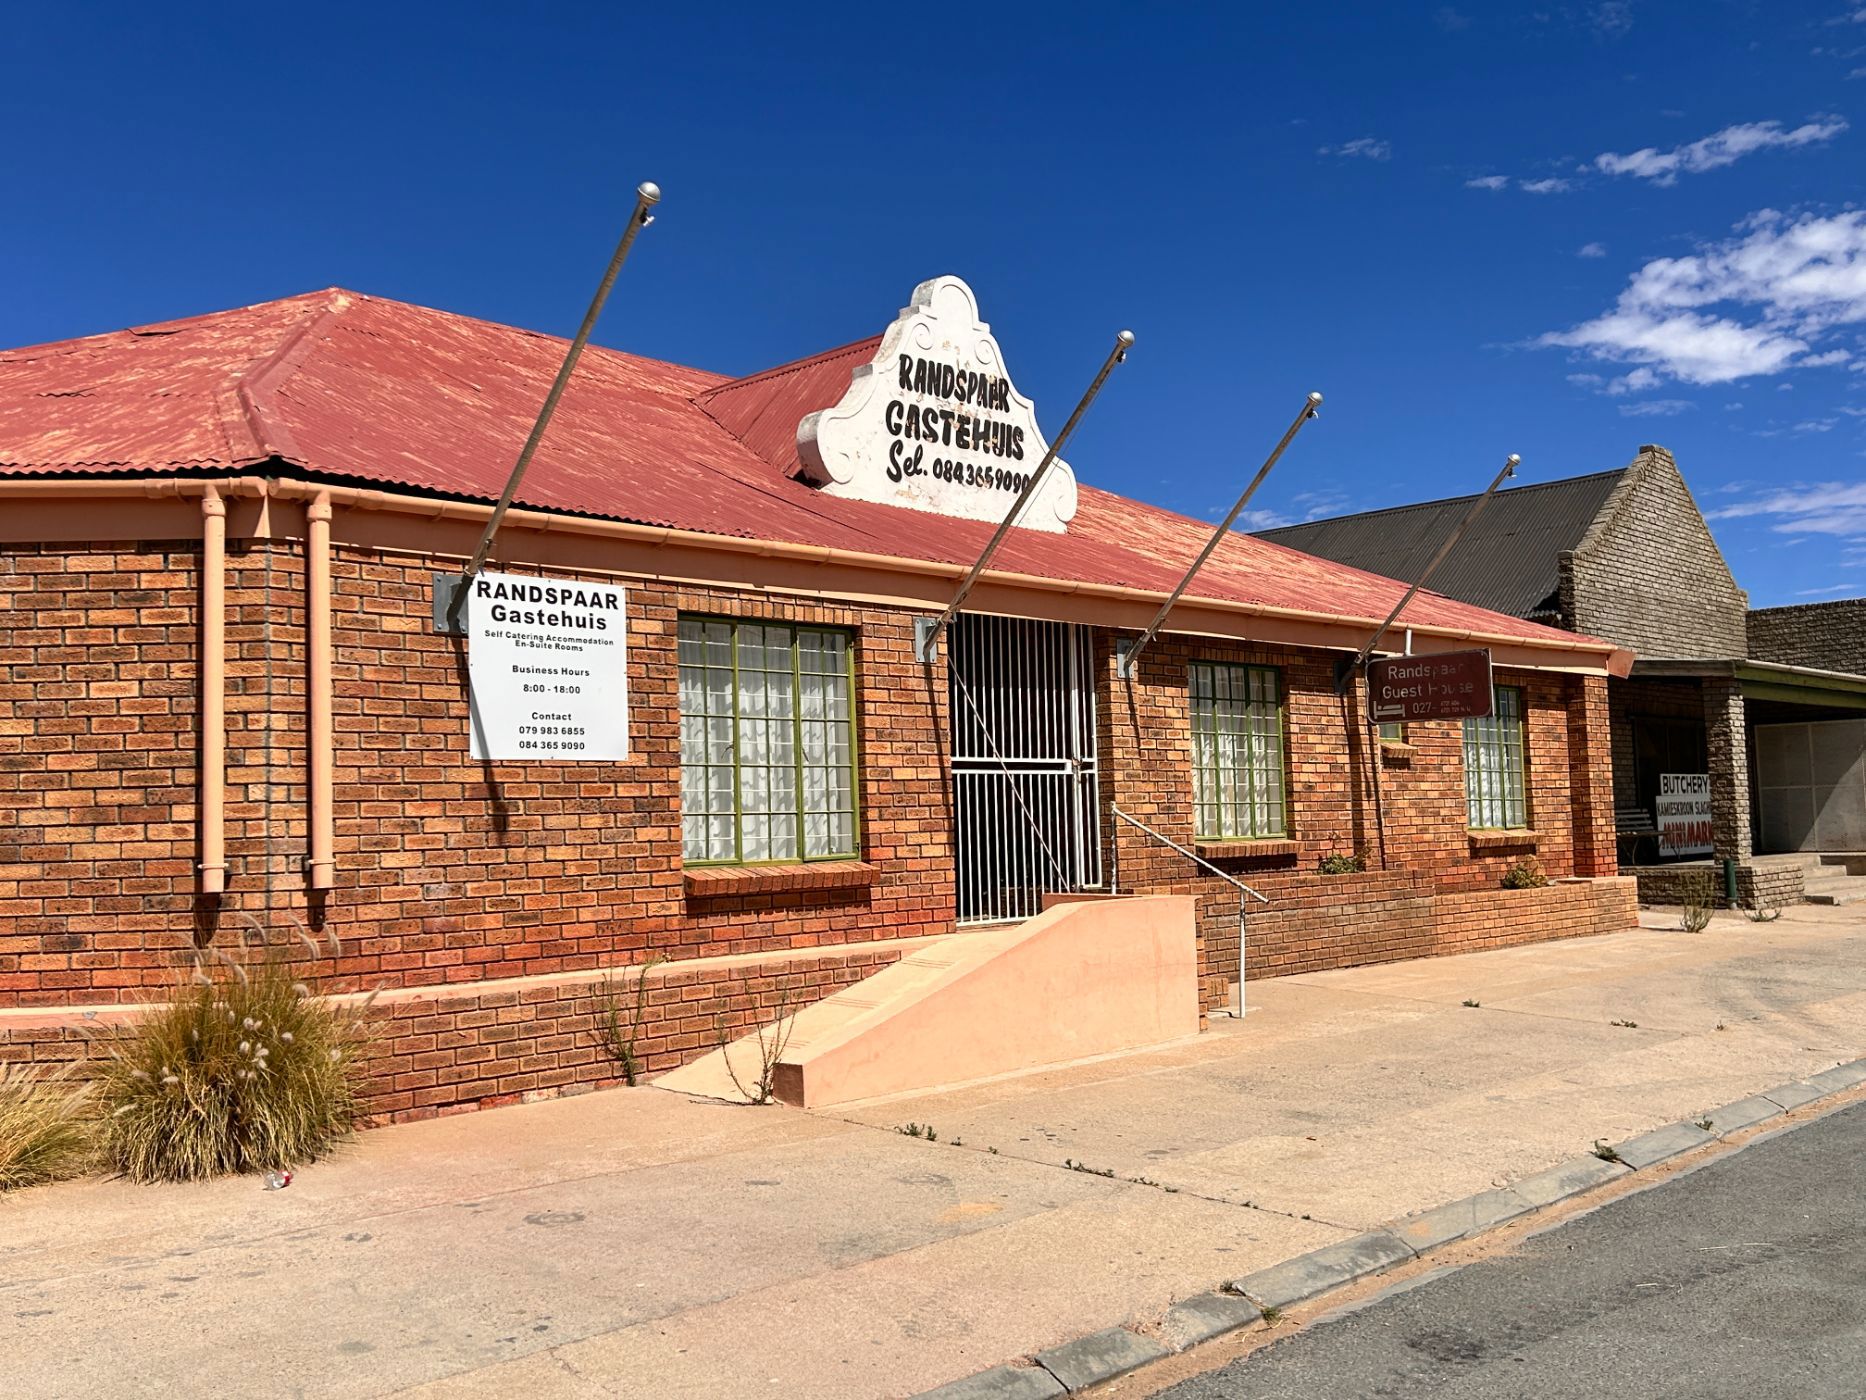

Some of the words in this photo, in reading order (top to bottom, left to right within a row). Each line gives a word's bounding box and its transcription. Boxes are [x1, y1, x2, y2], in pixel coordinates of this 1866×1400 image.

[899, 353, 1010, 413] RANDSPAAR
[885, 400, 1024, 460] GASTEHUIS
[886, 439, 928, 483] Sel.
[477, 580, 619, 610] RANDSPAAR
[491, 604, 607, 630] Gastehuis
[485, 630, 503, 638] Self
[505, 631, 544, 643] Catering
[546, 634, 614, 646] Accommodation
[515, 640, 553, 650] En-Suite
[554, 643, 584, 652] Rooms
[512, 664, 558, 675] Business
[561, 667, 590, 677] Hours
[523, 684, 545, 693] 8:00
[554, 685, 581, 694] 18:00
[1382, 683, 1422, 699] Guest
[531, 711, 572, 721] Contact
[518, 726, 538, 735] 079
[540, 726, 558, 735] 983
[561, 726, 585, 736] 6855
[518, 740, 538, 749] 084
[540, 740, 559, 750] 365
[561, 741, 585, 750] 9090
[1662, 775, 1709, 794] BUTCHERY
